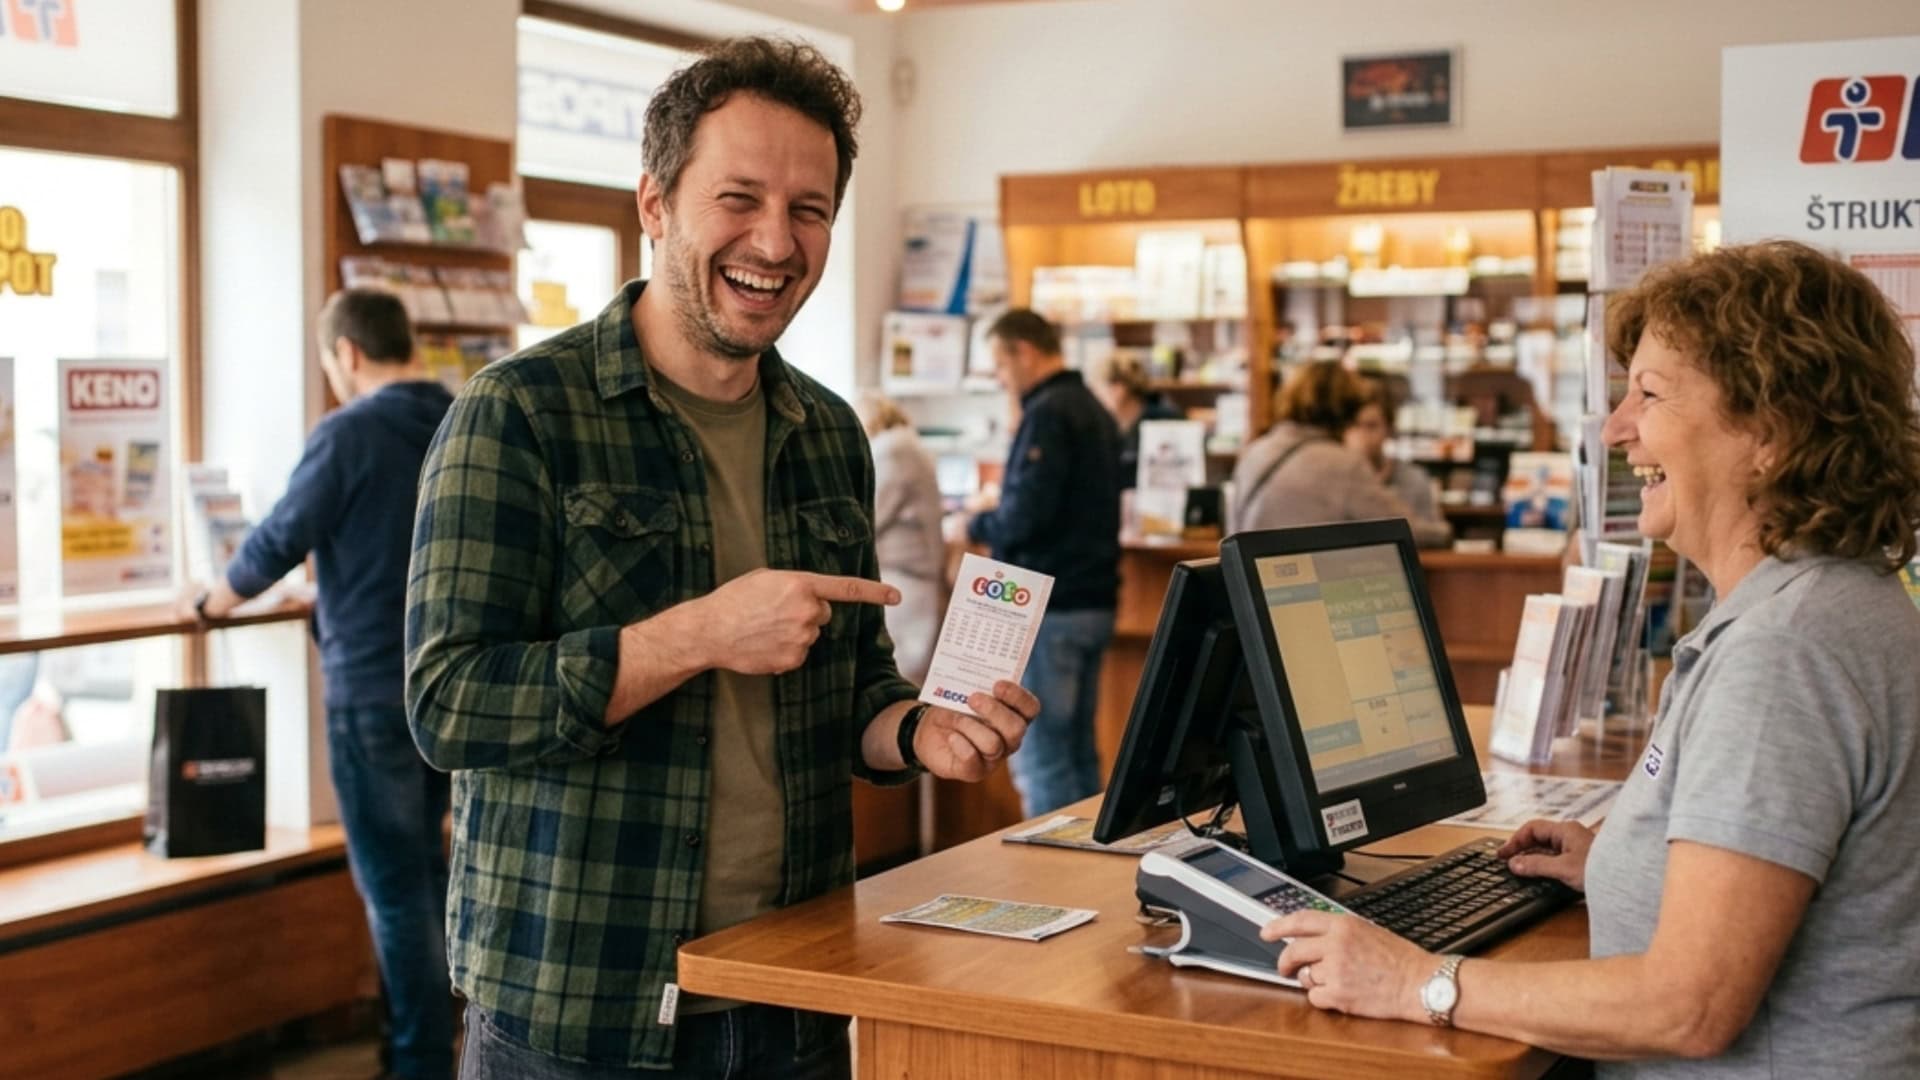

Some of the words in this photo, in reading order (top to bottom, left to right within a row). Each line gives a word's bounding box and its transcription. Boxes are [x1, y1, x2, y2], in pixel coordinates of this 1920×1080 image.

[1079, 179, 1155, 217] LOTO
[1337, 164, 1439, 208] ŽREBY
[71, 371, 157, 407] KENO
